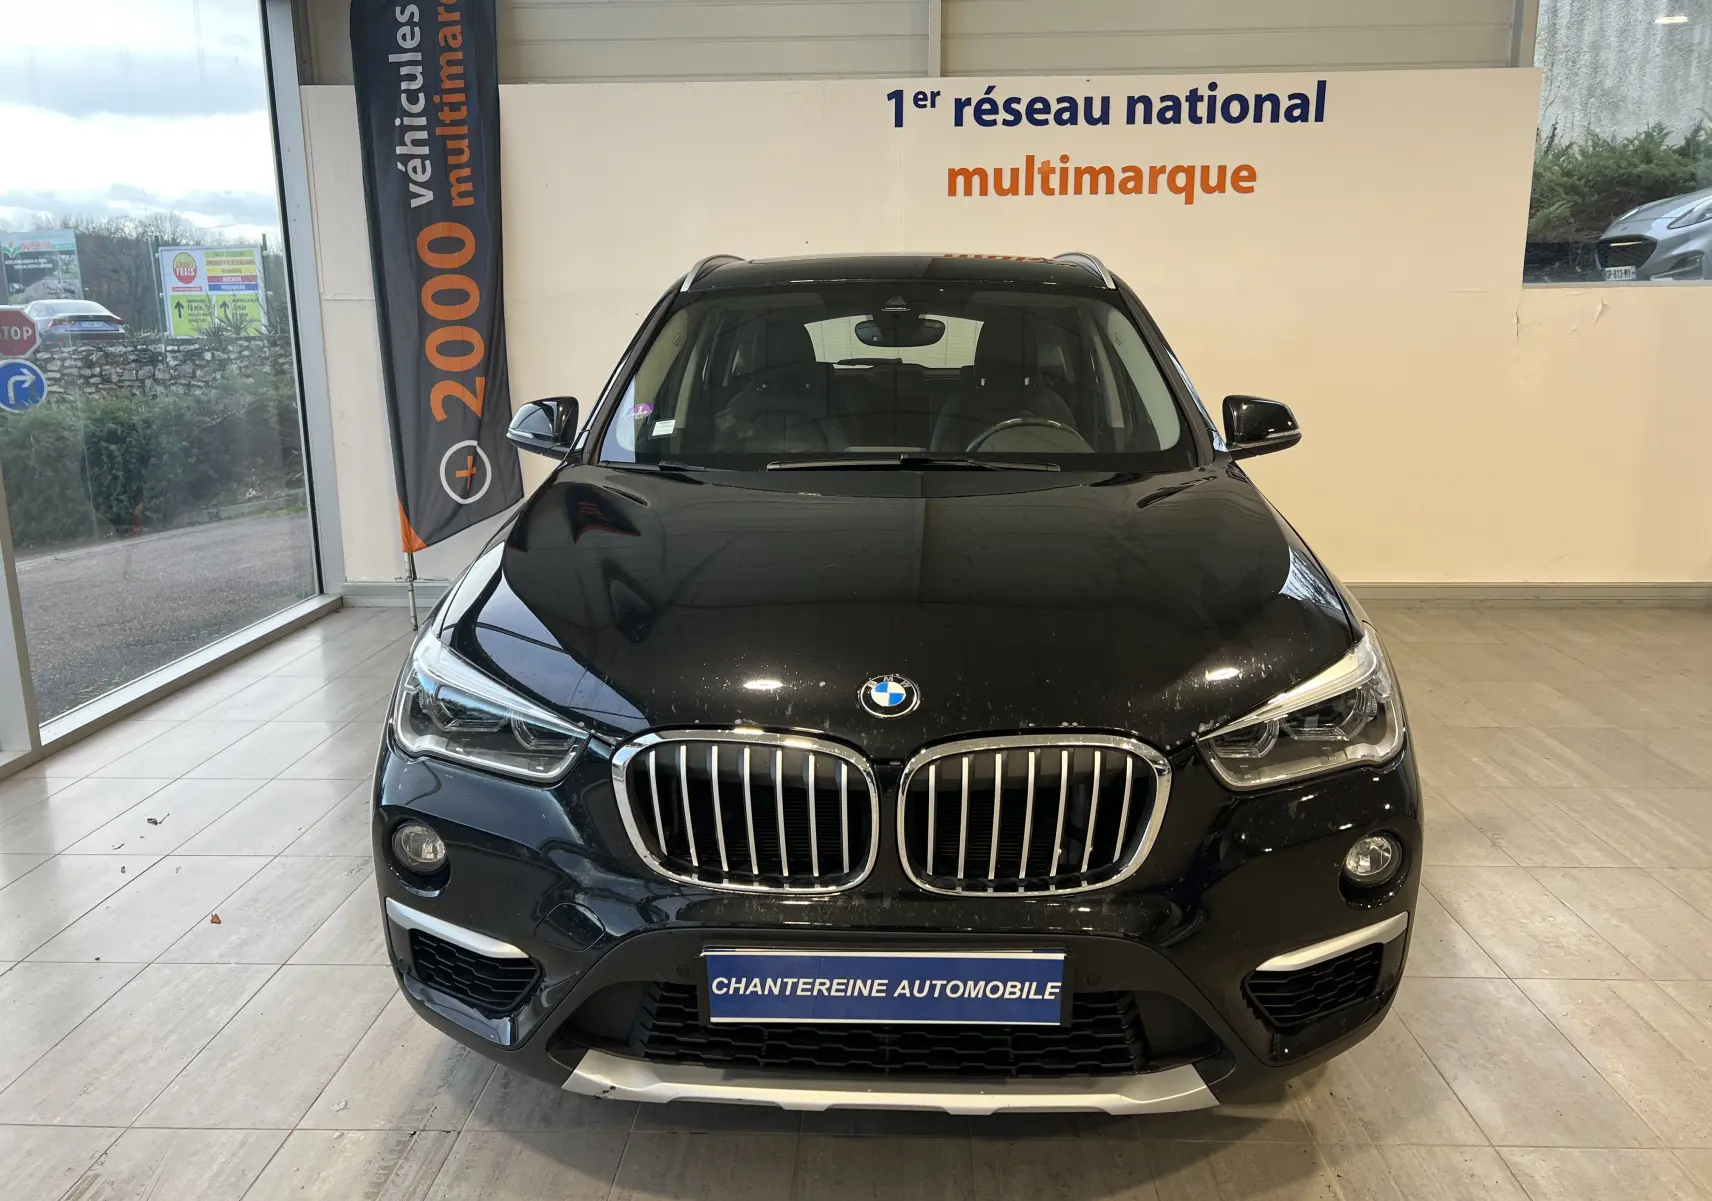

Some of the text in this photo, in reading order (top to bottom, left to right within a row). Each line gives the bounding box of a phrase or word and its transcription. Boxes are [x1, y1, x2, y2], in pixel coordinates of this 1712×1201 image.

[388, 4, 434, 208] véhicules
[433, 0, 475, 207] multimar
[887, 80, 1327, 127] 1er réseau national
[947, 154, 1257, 205] multimarque
[0, 326, 32, 340] TOP
[417, 222, 486, 421] 2000
[711, 977, 1061, 1000] CHANTEREINE AUTOMOBILE
